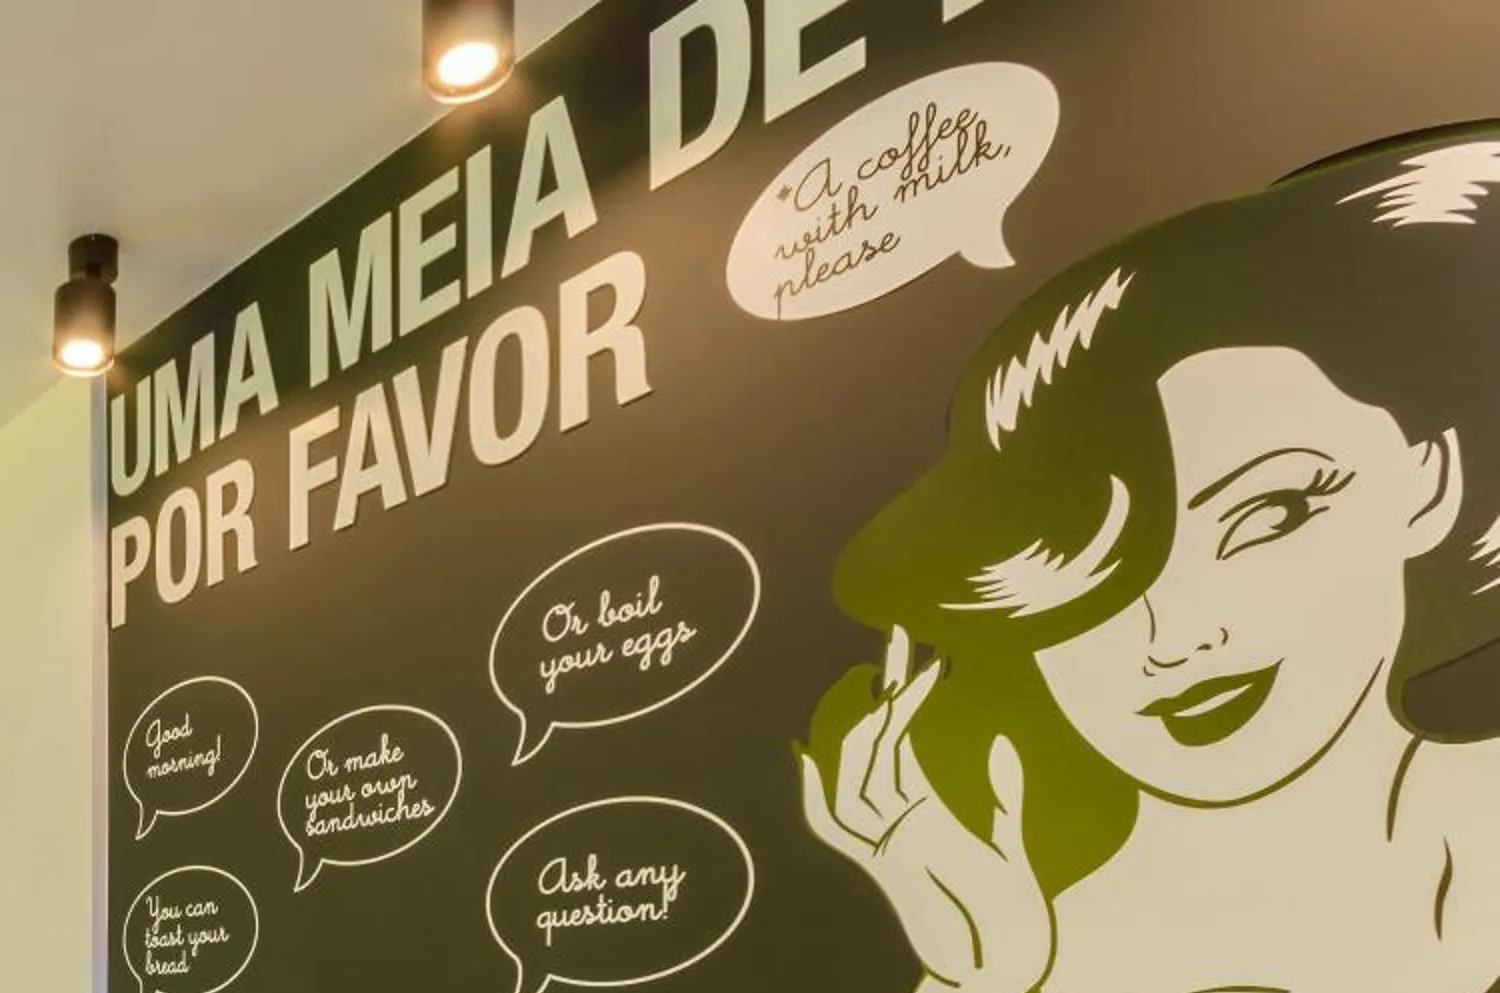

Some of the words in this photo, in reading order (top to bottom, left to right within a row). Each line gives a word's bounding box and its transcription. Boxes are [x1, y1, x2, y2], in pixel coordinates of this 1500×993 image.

[857, 102, 979, 181] coffee
[774, 185, 879, 260] with
[111, 302, 279, 497] UMA
[309, 95, 598, 388] MEIA
[649, 0, 868, 191] DE
[773, 231, 901, 320] please
[111, 458, 258, 628] POR
[289, 251, 653, 551] FAVOR
[542, 601, 589, 642] Or
[597, 574, 663, 627] boil
[540, 642, 613, 695] your
[621, 621, 697, 671] eggs
[146, 712, 193, 759] Good
[147, 734, 222, 777] morning!
[307, 748, 338, 780] Or
[344, 733, 404, 772] make
[305, 784, 356, 822] your
[361, 774, 418, 798] own
[305, 795, 435, 836] sandwiches
[538, 853, 607, 895] Ask
[615, 864, 687, 902] any
[146, 896, 182, 934] You
[185, 899, 218, 917] can
[536, 886, 669, 947] question!
[145, 924, 185, 950] toast
[187, 926, 229, 957] your
[145, 949, 190, 976] bread
